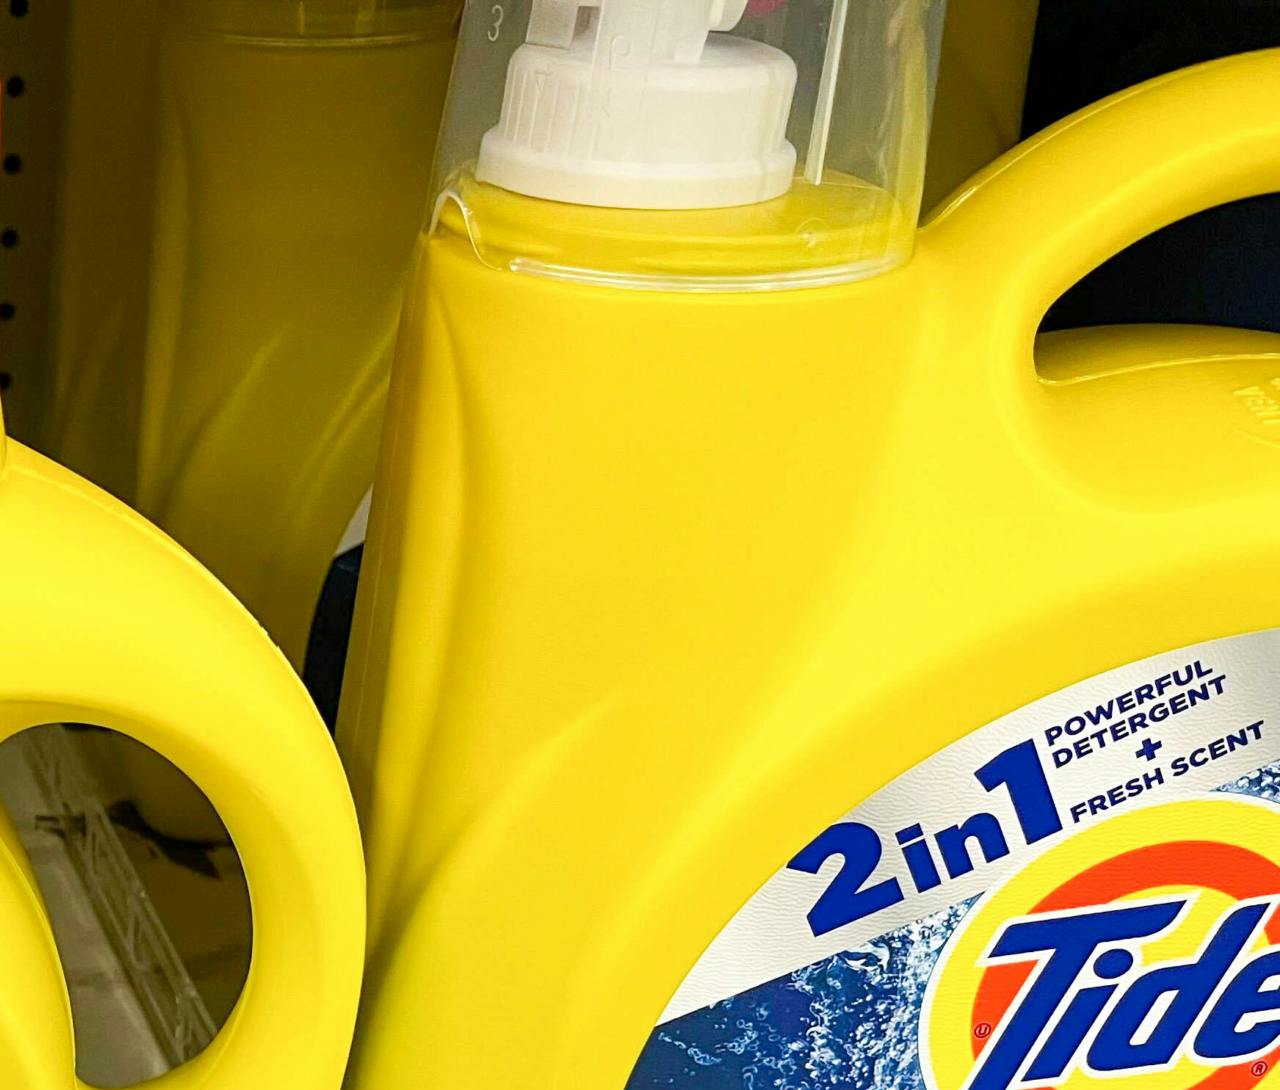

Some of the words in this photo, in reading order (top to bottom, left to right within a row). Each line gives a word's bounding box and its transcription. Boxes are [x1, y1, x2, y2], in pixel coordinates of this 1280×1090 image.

[1045, 660, 1213, 747] POWERFUL
[1052, 674, 1226, 769] DETERGENT
[1070, 767, 1164, 824] FRESH
[1171, 720, 1265, 777] SCENT
[786, 738, 1064, 938] 2in1
